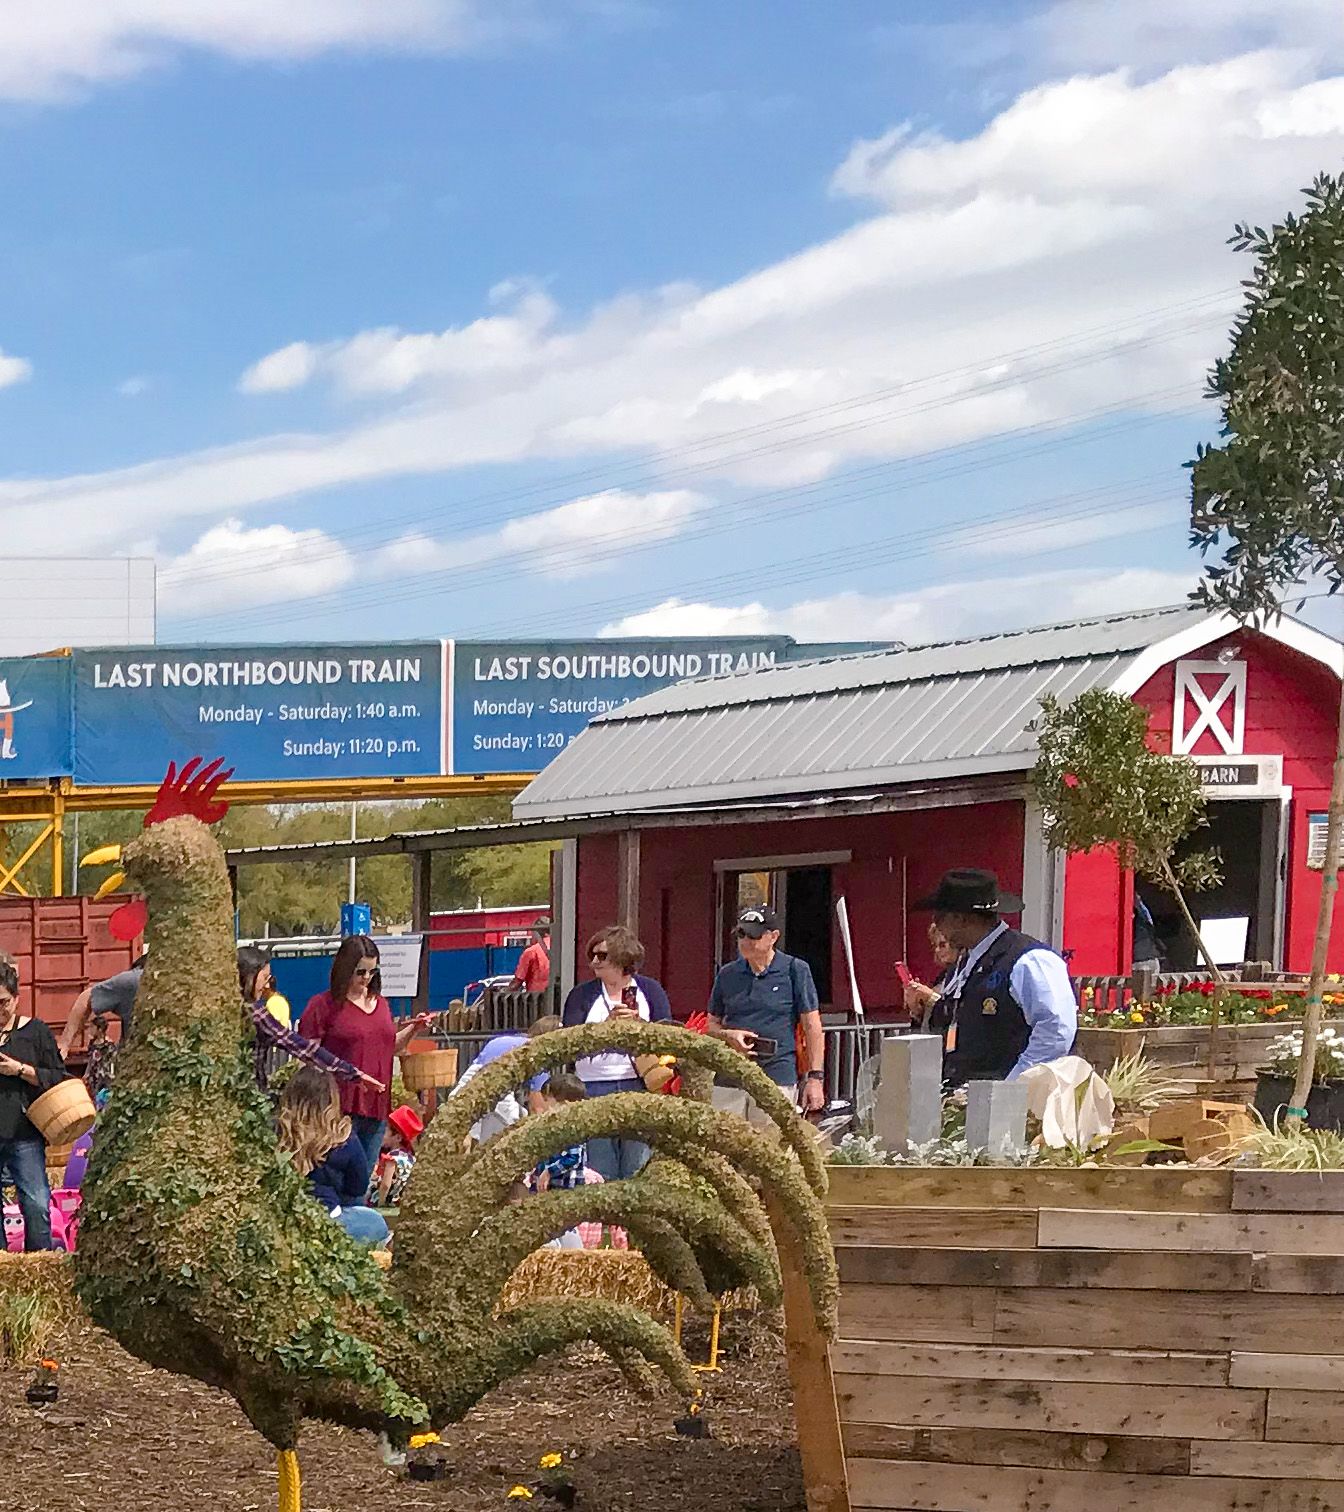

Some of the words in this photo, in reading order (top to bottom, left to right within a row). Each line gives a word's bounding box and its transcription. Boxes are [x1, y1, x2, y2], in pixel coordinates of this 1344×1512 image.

[94, 663, 156, 688] LAST
[163, 661, 342, 687] NORTHBOUND
[348, 659, 420, 683] TRAIN
[473, 656, 531, 681] LAST
[536, 654, 702, 679] SOUTHBOUND
[707, 651, 776, 675] TRAIN
[199, 706, 264, 725] Monday
[278, 703, 352, 722] Saturday:
[356, 703, 384, 719] 1:40
[388, 706, 421, 718] a.m.
[473, 699, 534, 718] Monday
[283, 740, 345, 759] Sunday:
[349, 739, 384, 754] 11:20
[387, 742, 421, 757] p.m.
[473, 733, 532, 752] Sunday:
[536, 733, 564, 748] 1:20
[1200, 767, 1240, 783] BARN
